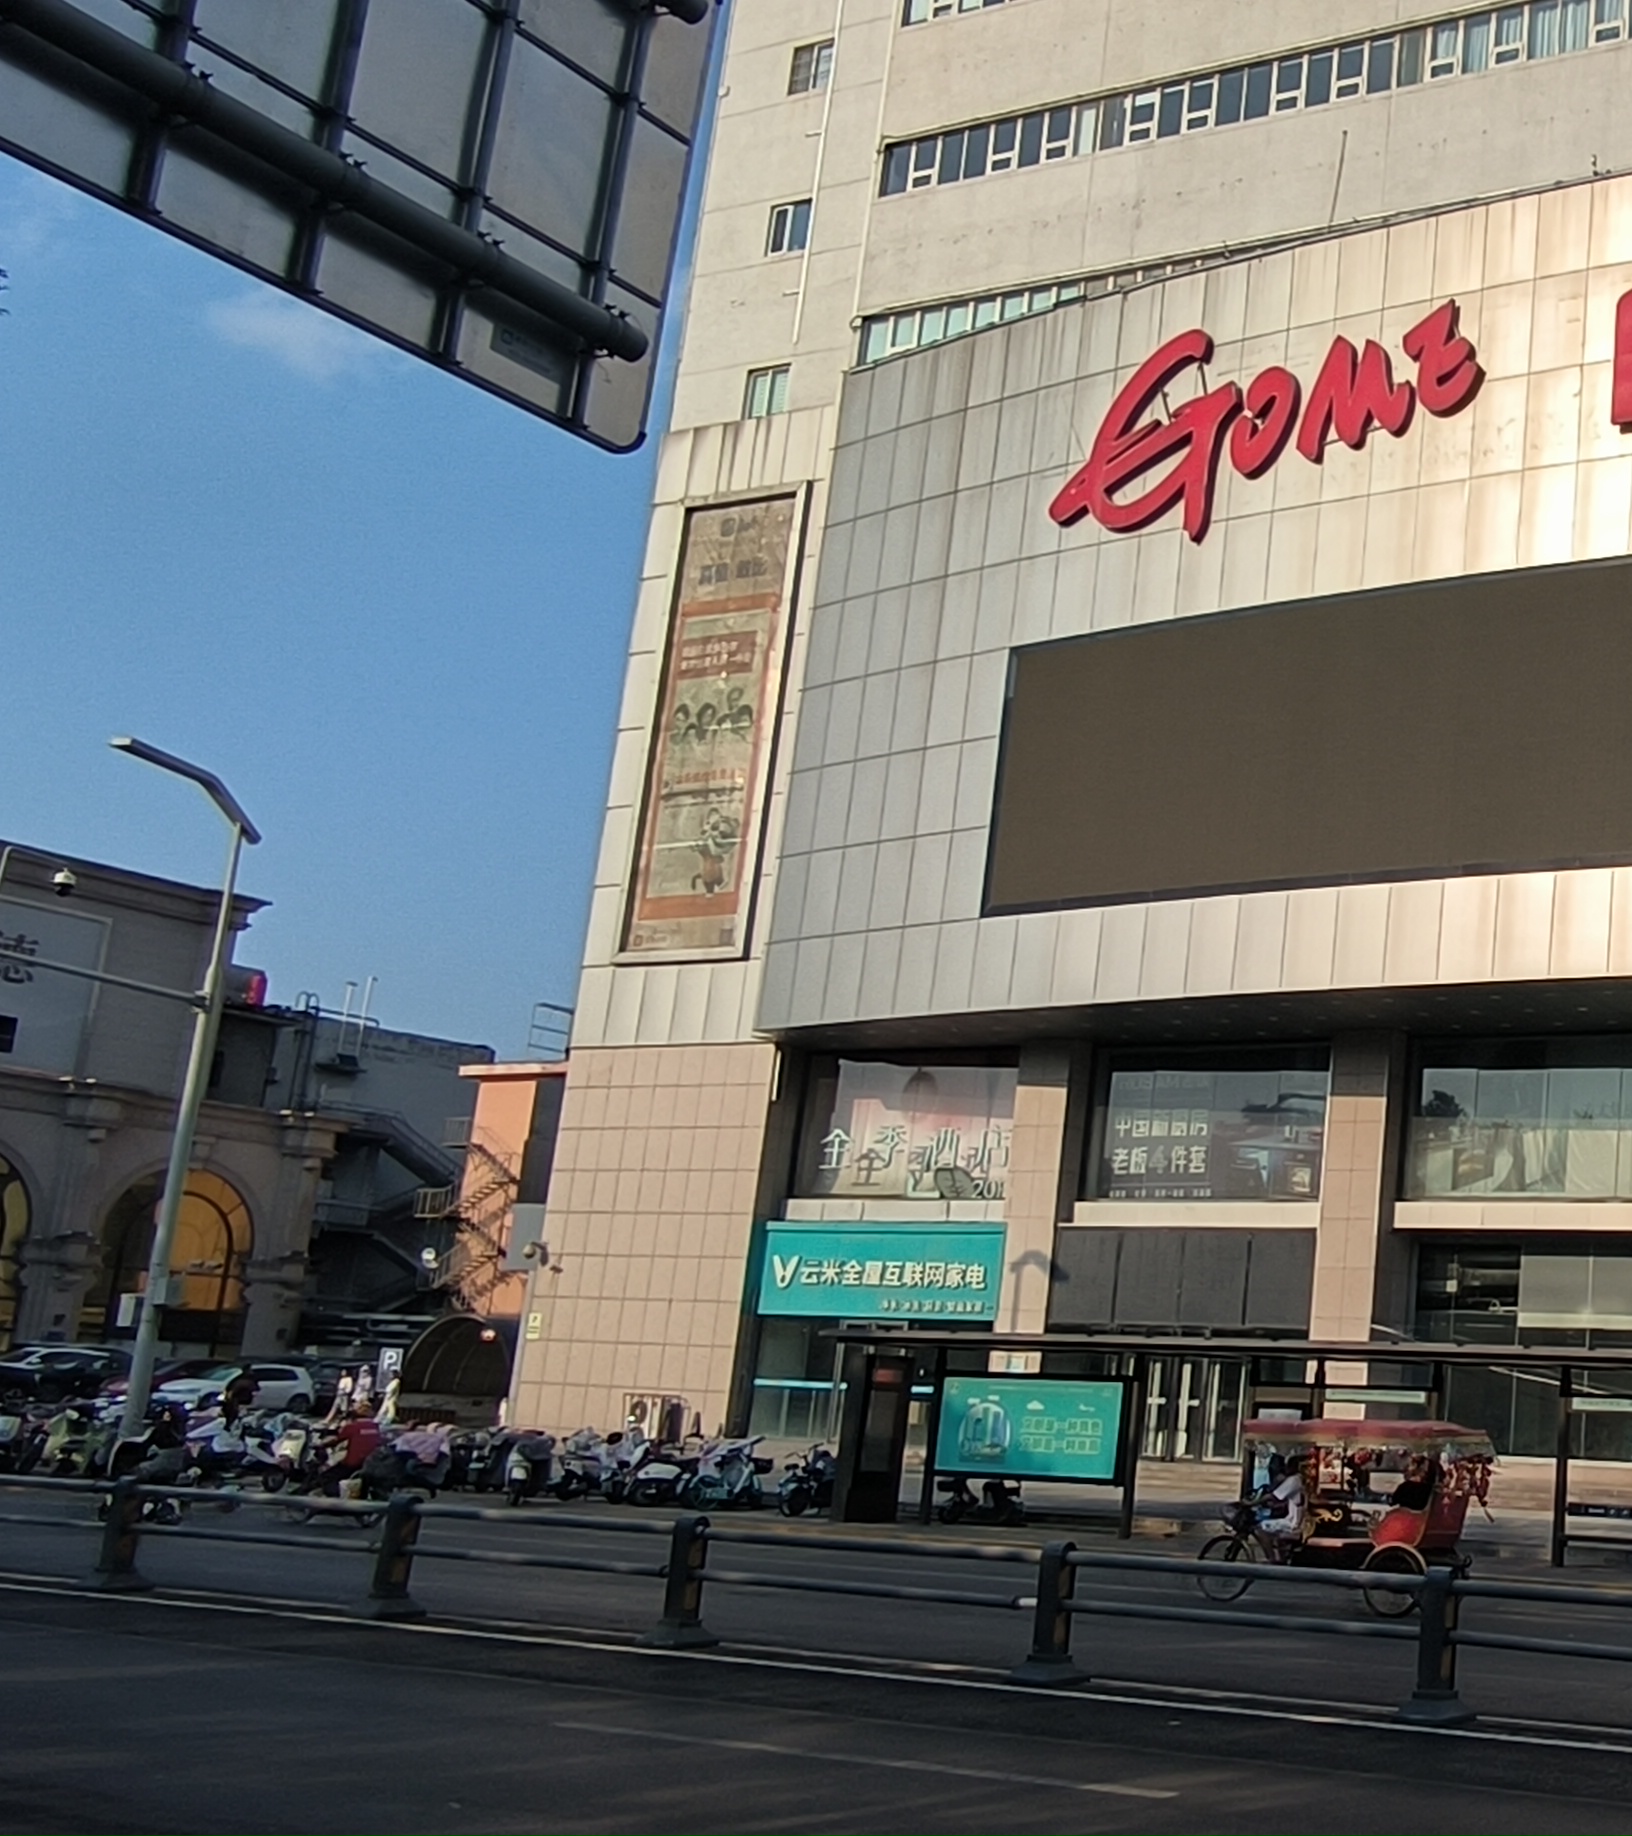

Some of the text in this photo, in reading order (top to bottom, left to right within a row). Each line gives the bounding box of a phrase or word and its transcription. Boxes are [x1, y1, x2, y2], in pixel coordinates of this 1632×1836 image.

[1111, 1145, 1207, 1175] 老板4件套
[801, 1259, 986, 1290] 云米全屋互联网家电
